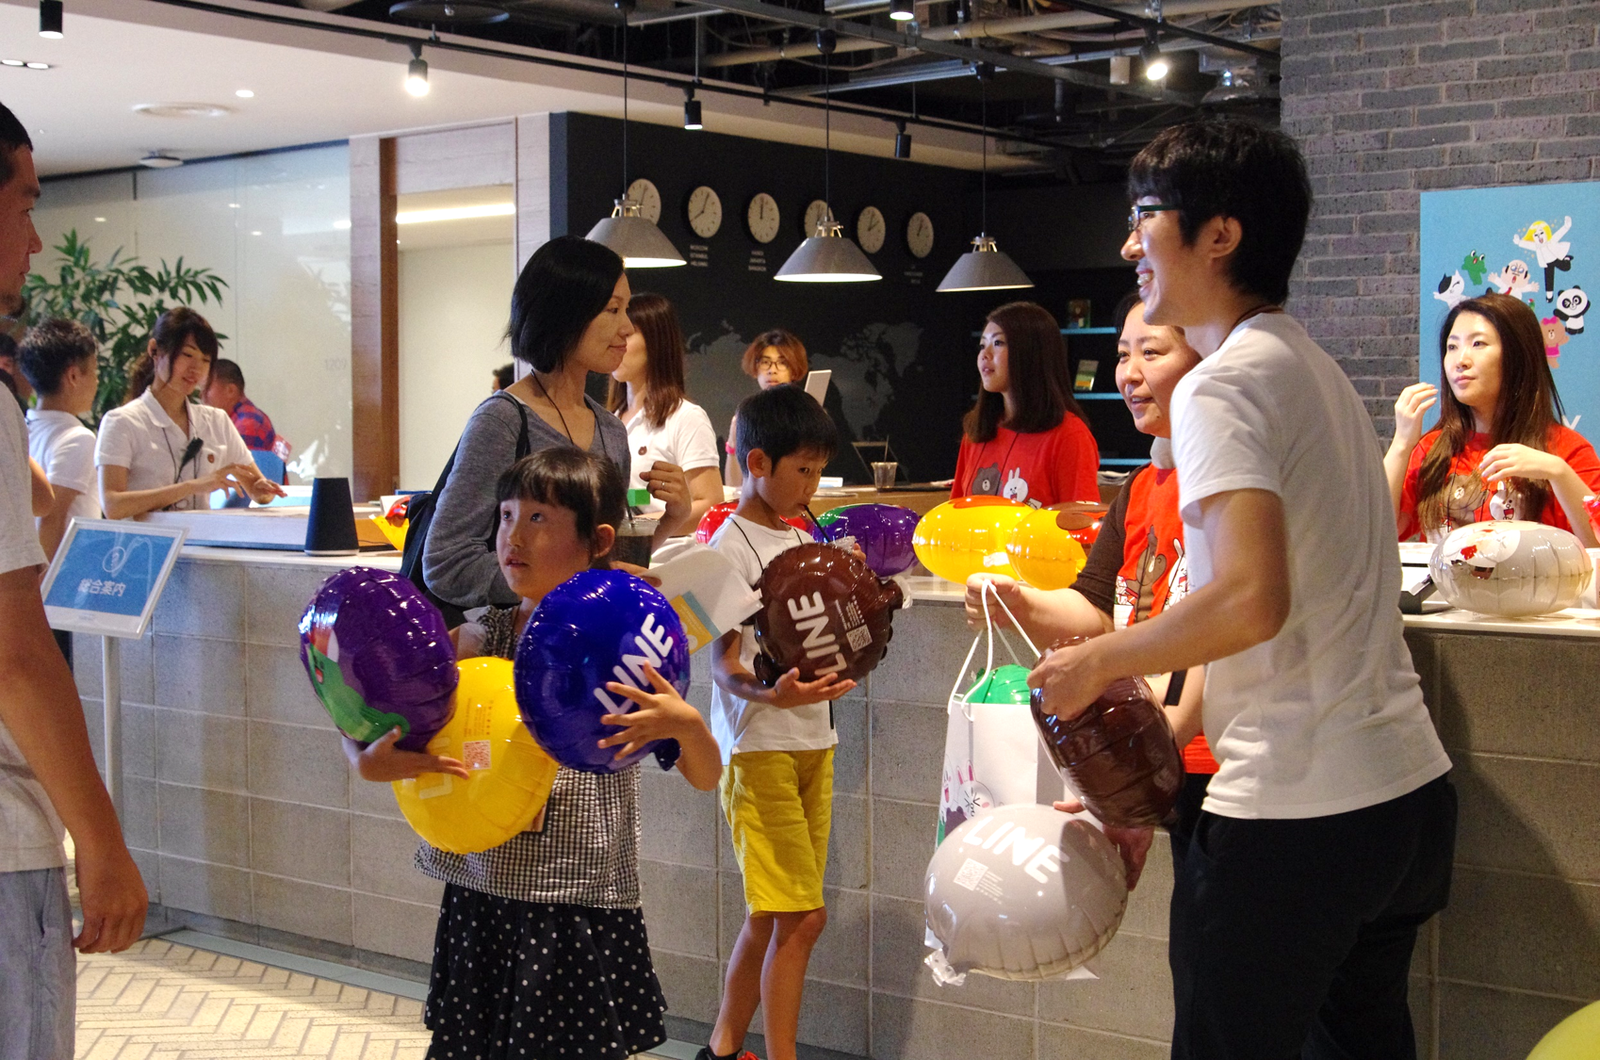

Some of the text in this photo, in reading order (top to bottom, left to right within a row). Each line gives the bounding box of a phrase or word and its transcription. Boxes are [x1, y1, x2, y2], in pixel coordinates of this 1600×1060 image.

[78, 578, 126, 597] 総合案内
[593, 613, 674, 716] LINE
[787, 591, 847, 677] LINE
[962, 815, 1070, 884] LINE
